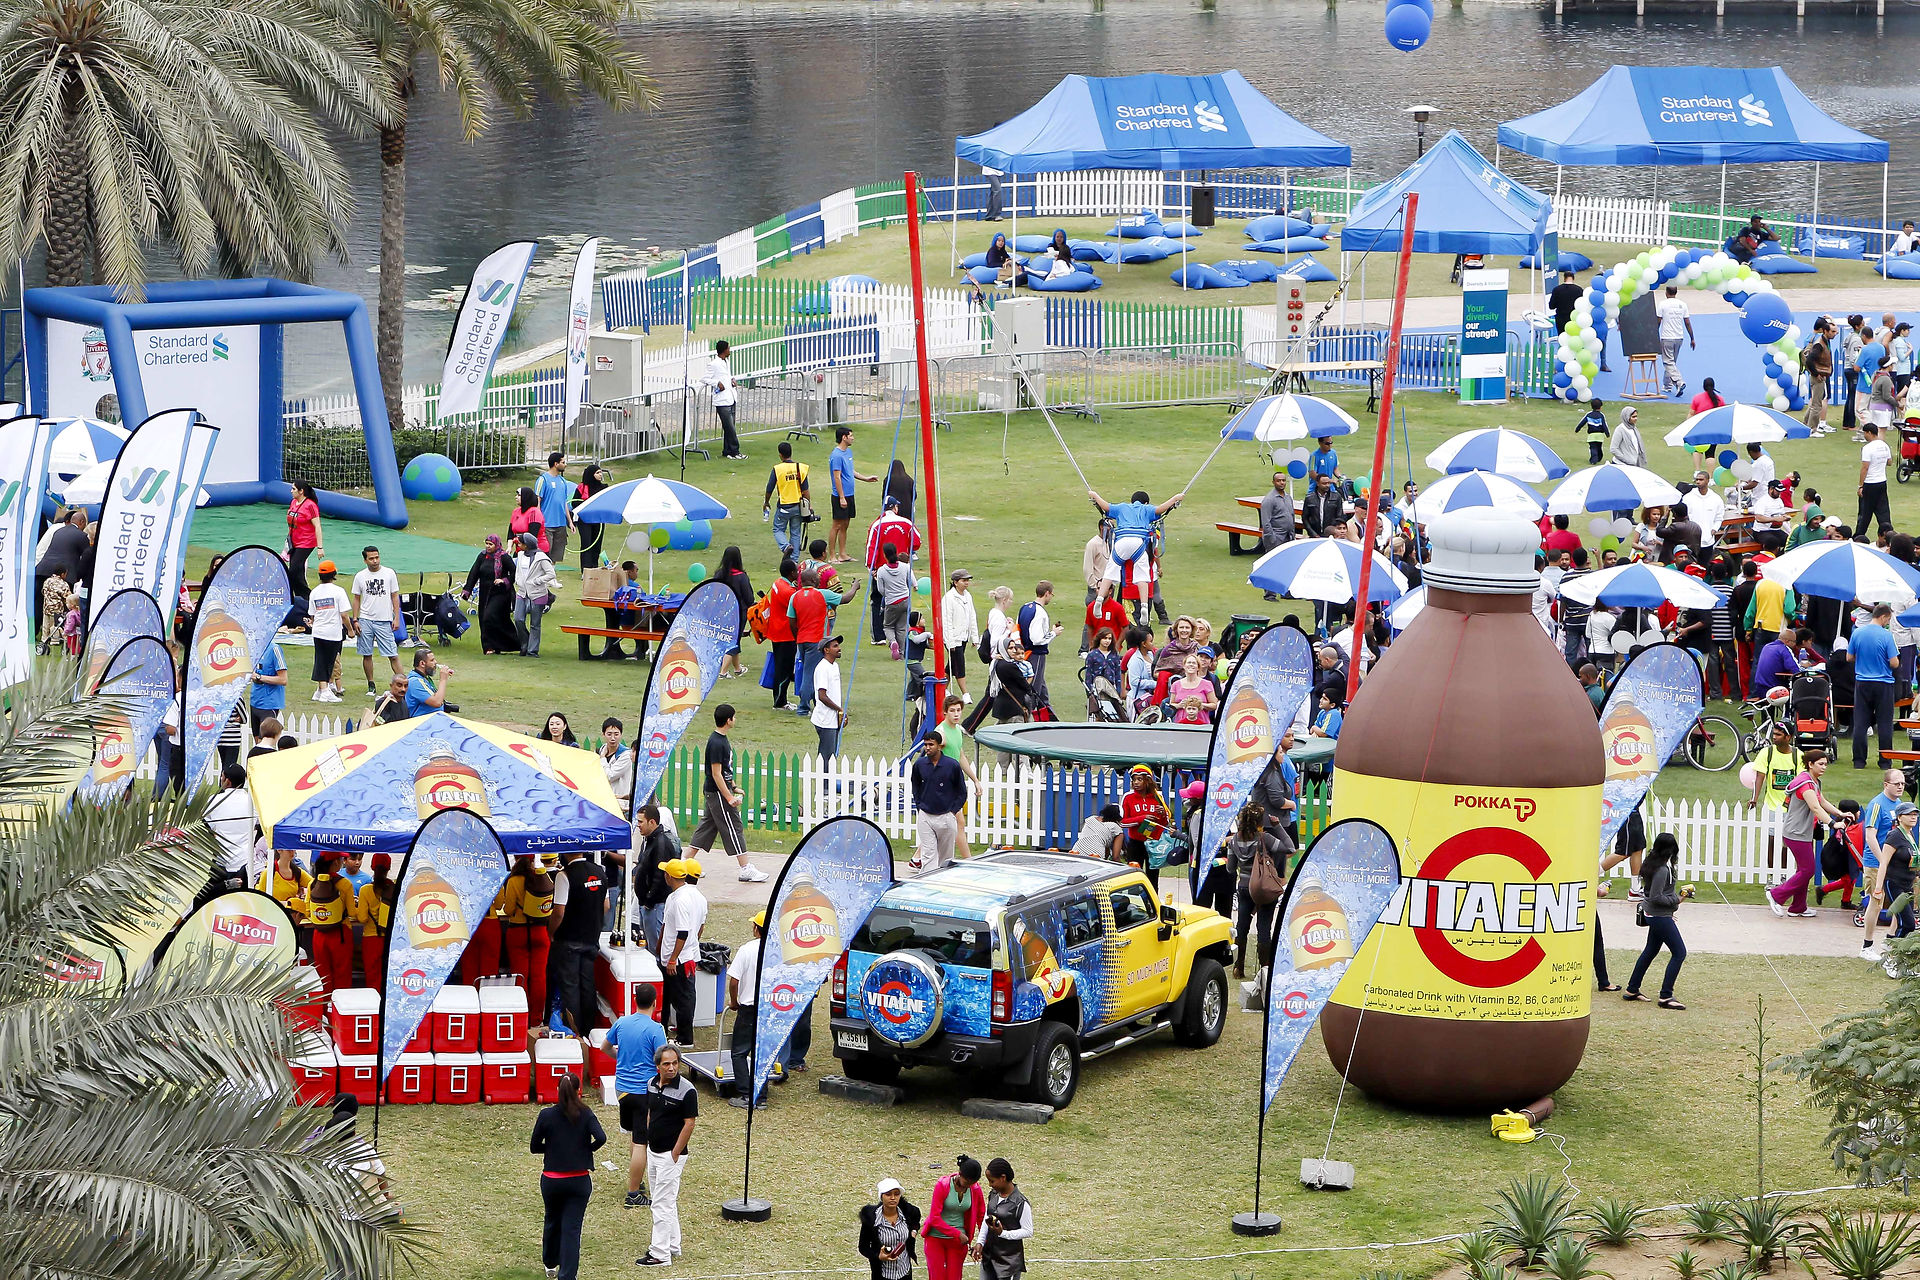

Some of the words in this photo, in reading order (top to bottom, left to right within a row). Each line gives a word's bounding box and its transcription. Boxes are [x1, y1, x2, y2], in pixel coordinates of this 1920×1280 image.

[1116, 102, 1188, 117] Standard
[1661, 94, 1733, 110] Standard
[1115, 117, 1192, 131] Chartered
[1660, 109, 1738, 123] Chartered
[1466, 304, 1484, 313] Your
[1466, 311, 1499, 322] diversity
[1465, 322, 1480, 330] our
[1465, 329, 1499, 339] strength
[149, 333, 208, 349] Standard
[455, 308, 486, 376] Standard
[467, 312, 500, 384] Chartered
[144, 350, 208, 366] Chartered
[107, 512, 136, 602] tandard
[133, 514, 156, 592] artered
[1453, 794, 1512, 810] POKKA
[300, 832, 313, 843] SO
[316, 833, 345, 845] MUCH
[348, 834, 376, 846] MORE
[437, 855, 448, 865] SO
[450, 856, 474, 867] MUCH
[476, 859, 500, 870] MORE
[817, 868, 829, 879] SO
[831, 870, 857, 882] MUCH
[859, 872, 883, 884] MORE
[1325, 872, 1337, 883] SO
[1339, 872, 1364, 884] MUCH
[1366, 873, 1391, 885] MORE
[155, 894, 181, 905] akes
[1378, 875, 1588, 933] VITAENE
[899, 904, 955, 917] www.vitaenec.com
[217, 917, 272, 941] Lipton
[867, 990, 927, 1014] VITAENE
[1363, 983, 1414, 999] Carbonated
[1417, 990, 1443, 1002] Drink
[1445, 993, 1465, 1003] with
[1468, 994, 1504, 1005] Vitamin
[1541, 995, 1548, 1005] C
[1549, 995, 1563, 1004] and
